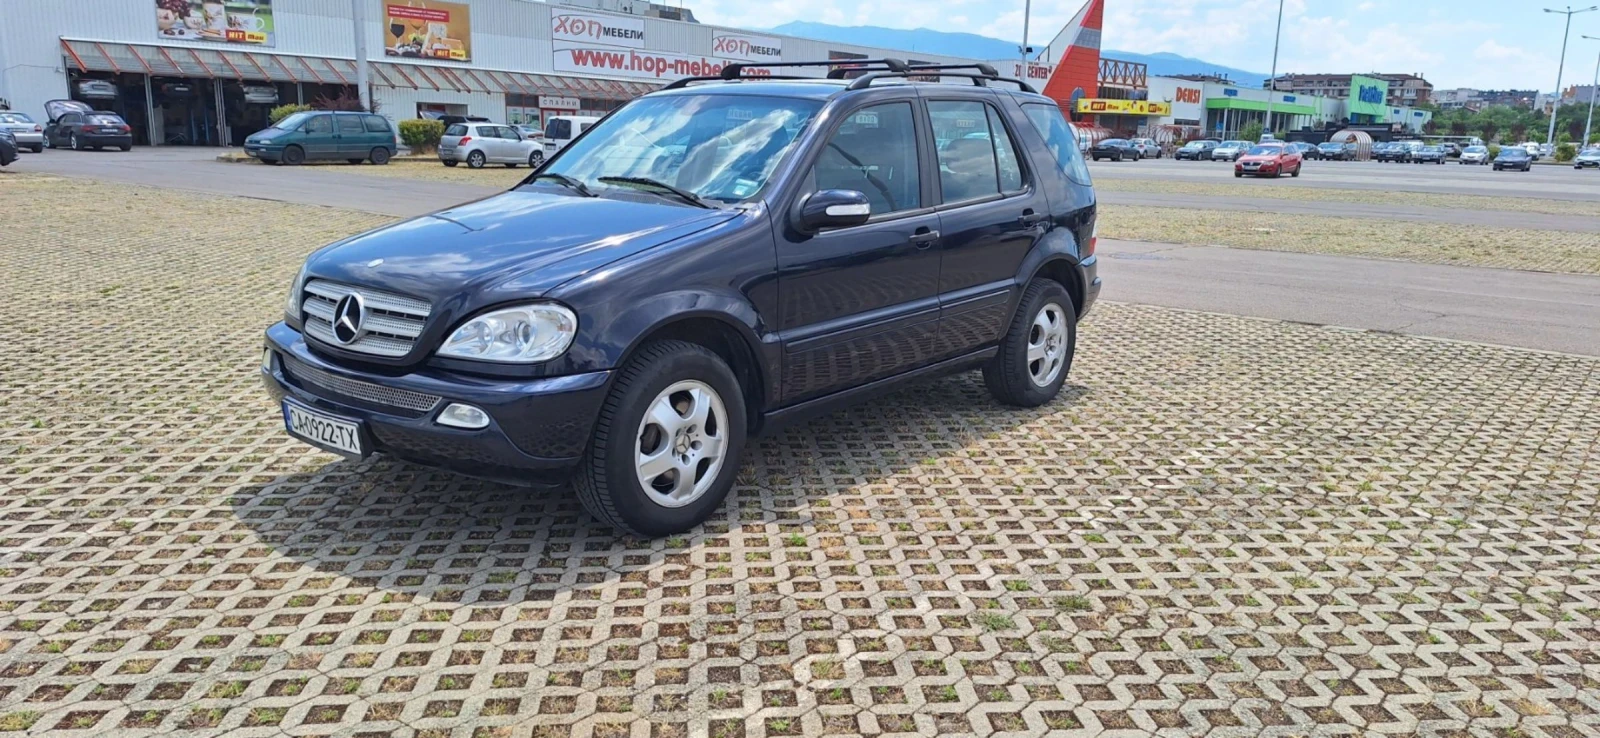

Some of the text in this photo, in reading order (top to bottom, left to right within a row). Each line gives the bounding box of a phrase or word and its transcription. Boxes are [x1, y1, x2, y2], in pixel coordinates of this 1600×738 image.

[228, 31, 244, 39] HIT
[554, 15, 644, 40] ХОП МЕБЕЛИ
[714, 37, 781, 57] ХОП МЕБЕЛИ
[1027, 65, 1048, 80] CENTER
[542, 99, 577, 107] СПАЛНИ
[1175, 86, 1201, 104] DENSI
